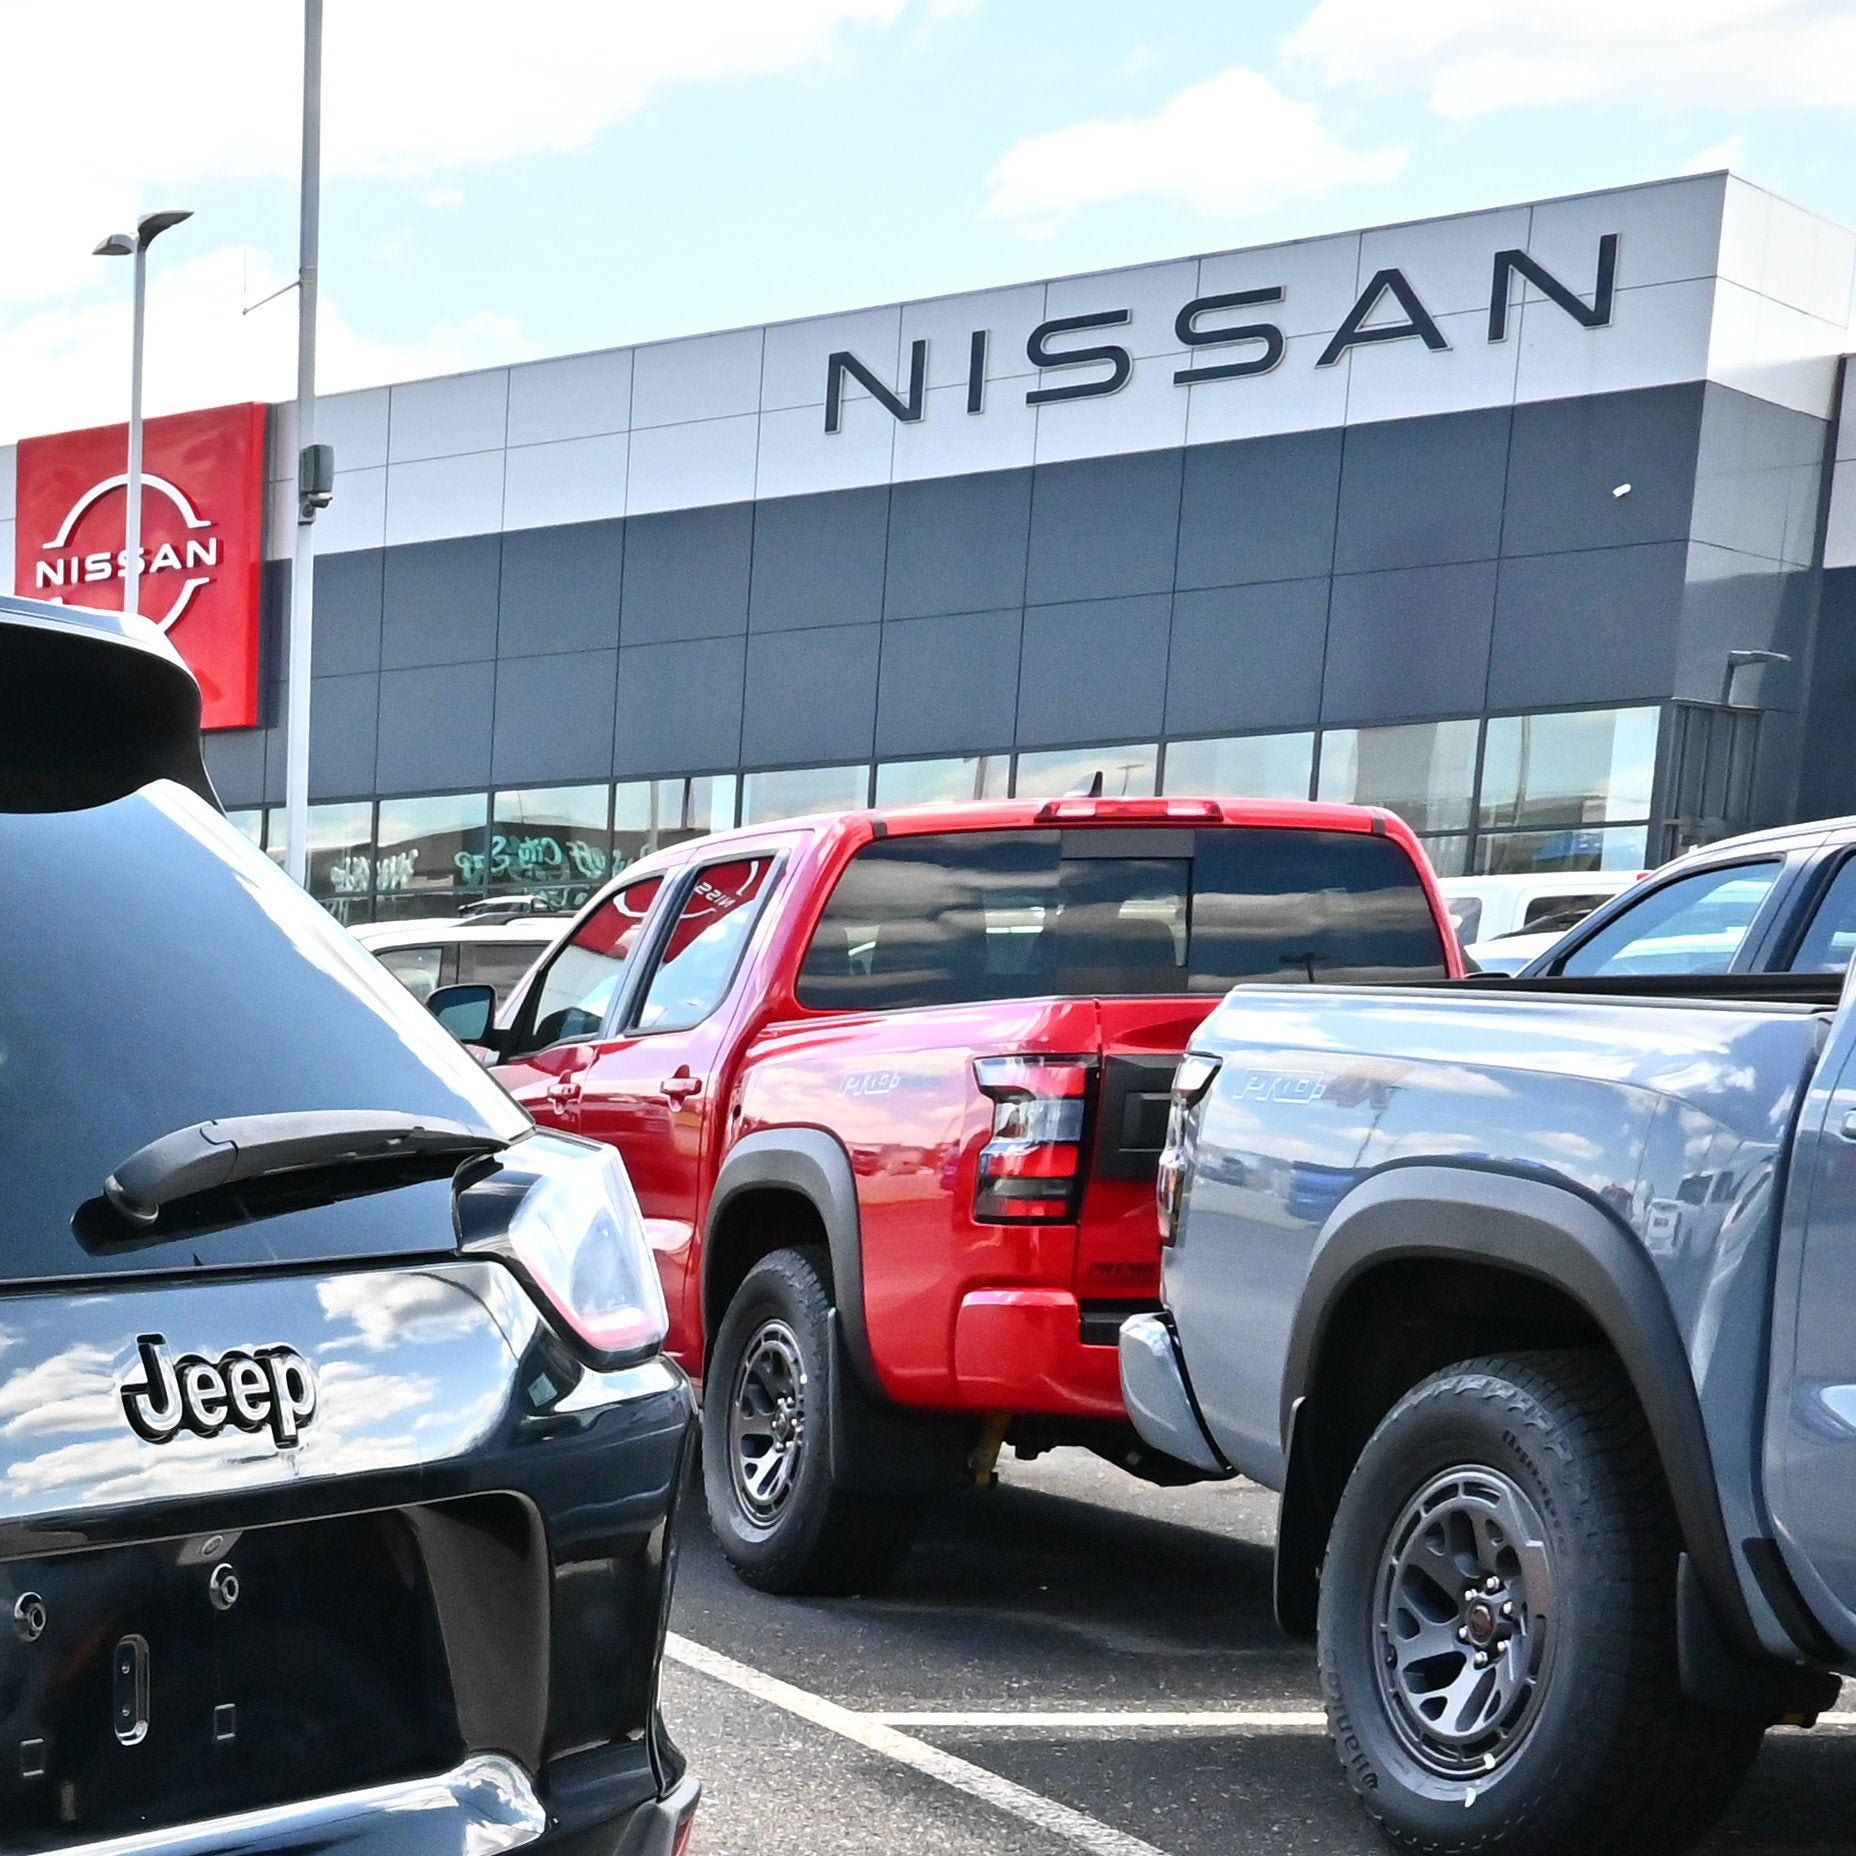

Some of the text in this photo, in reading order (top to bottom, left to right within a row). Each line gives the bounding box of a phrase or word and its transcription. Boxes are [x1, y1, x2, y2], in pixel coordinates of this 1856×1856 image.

[825, 234, 1620, 435] NISSAN
[36, 537, 217, 588] NISSAN
[119, 1332, 319, 1449] Jeep
